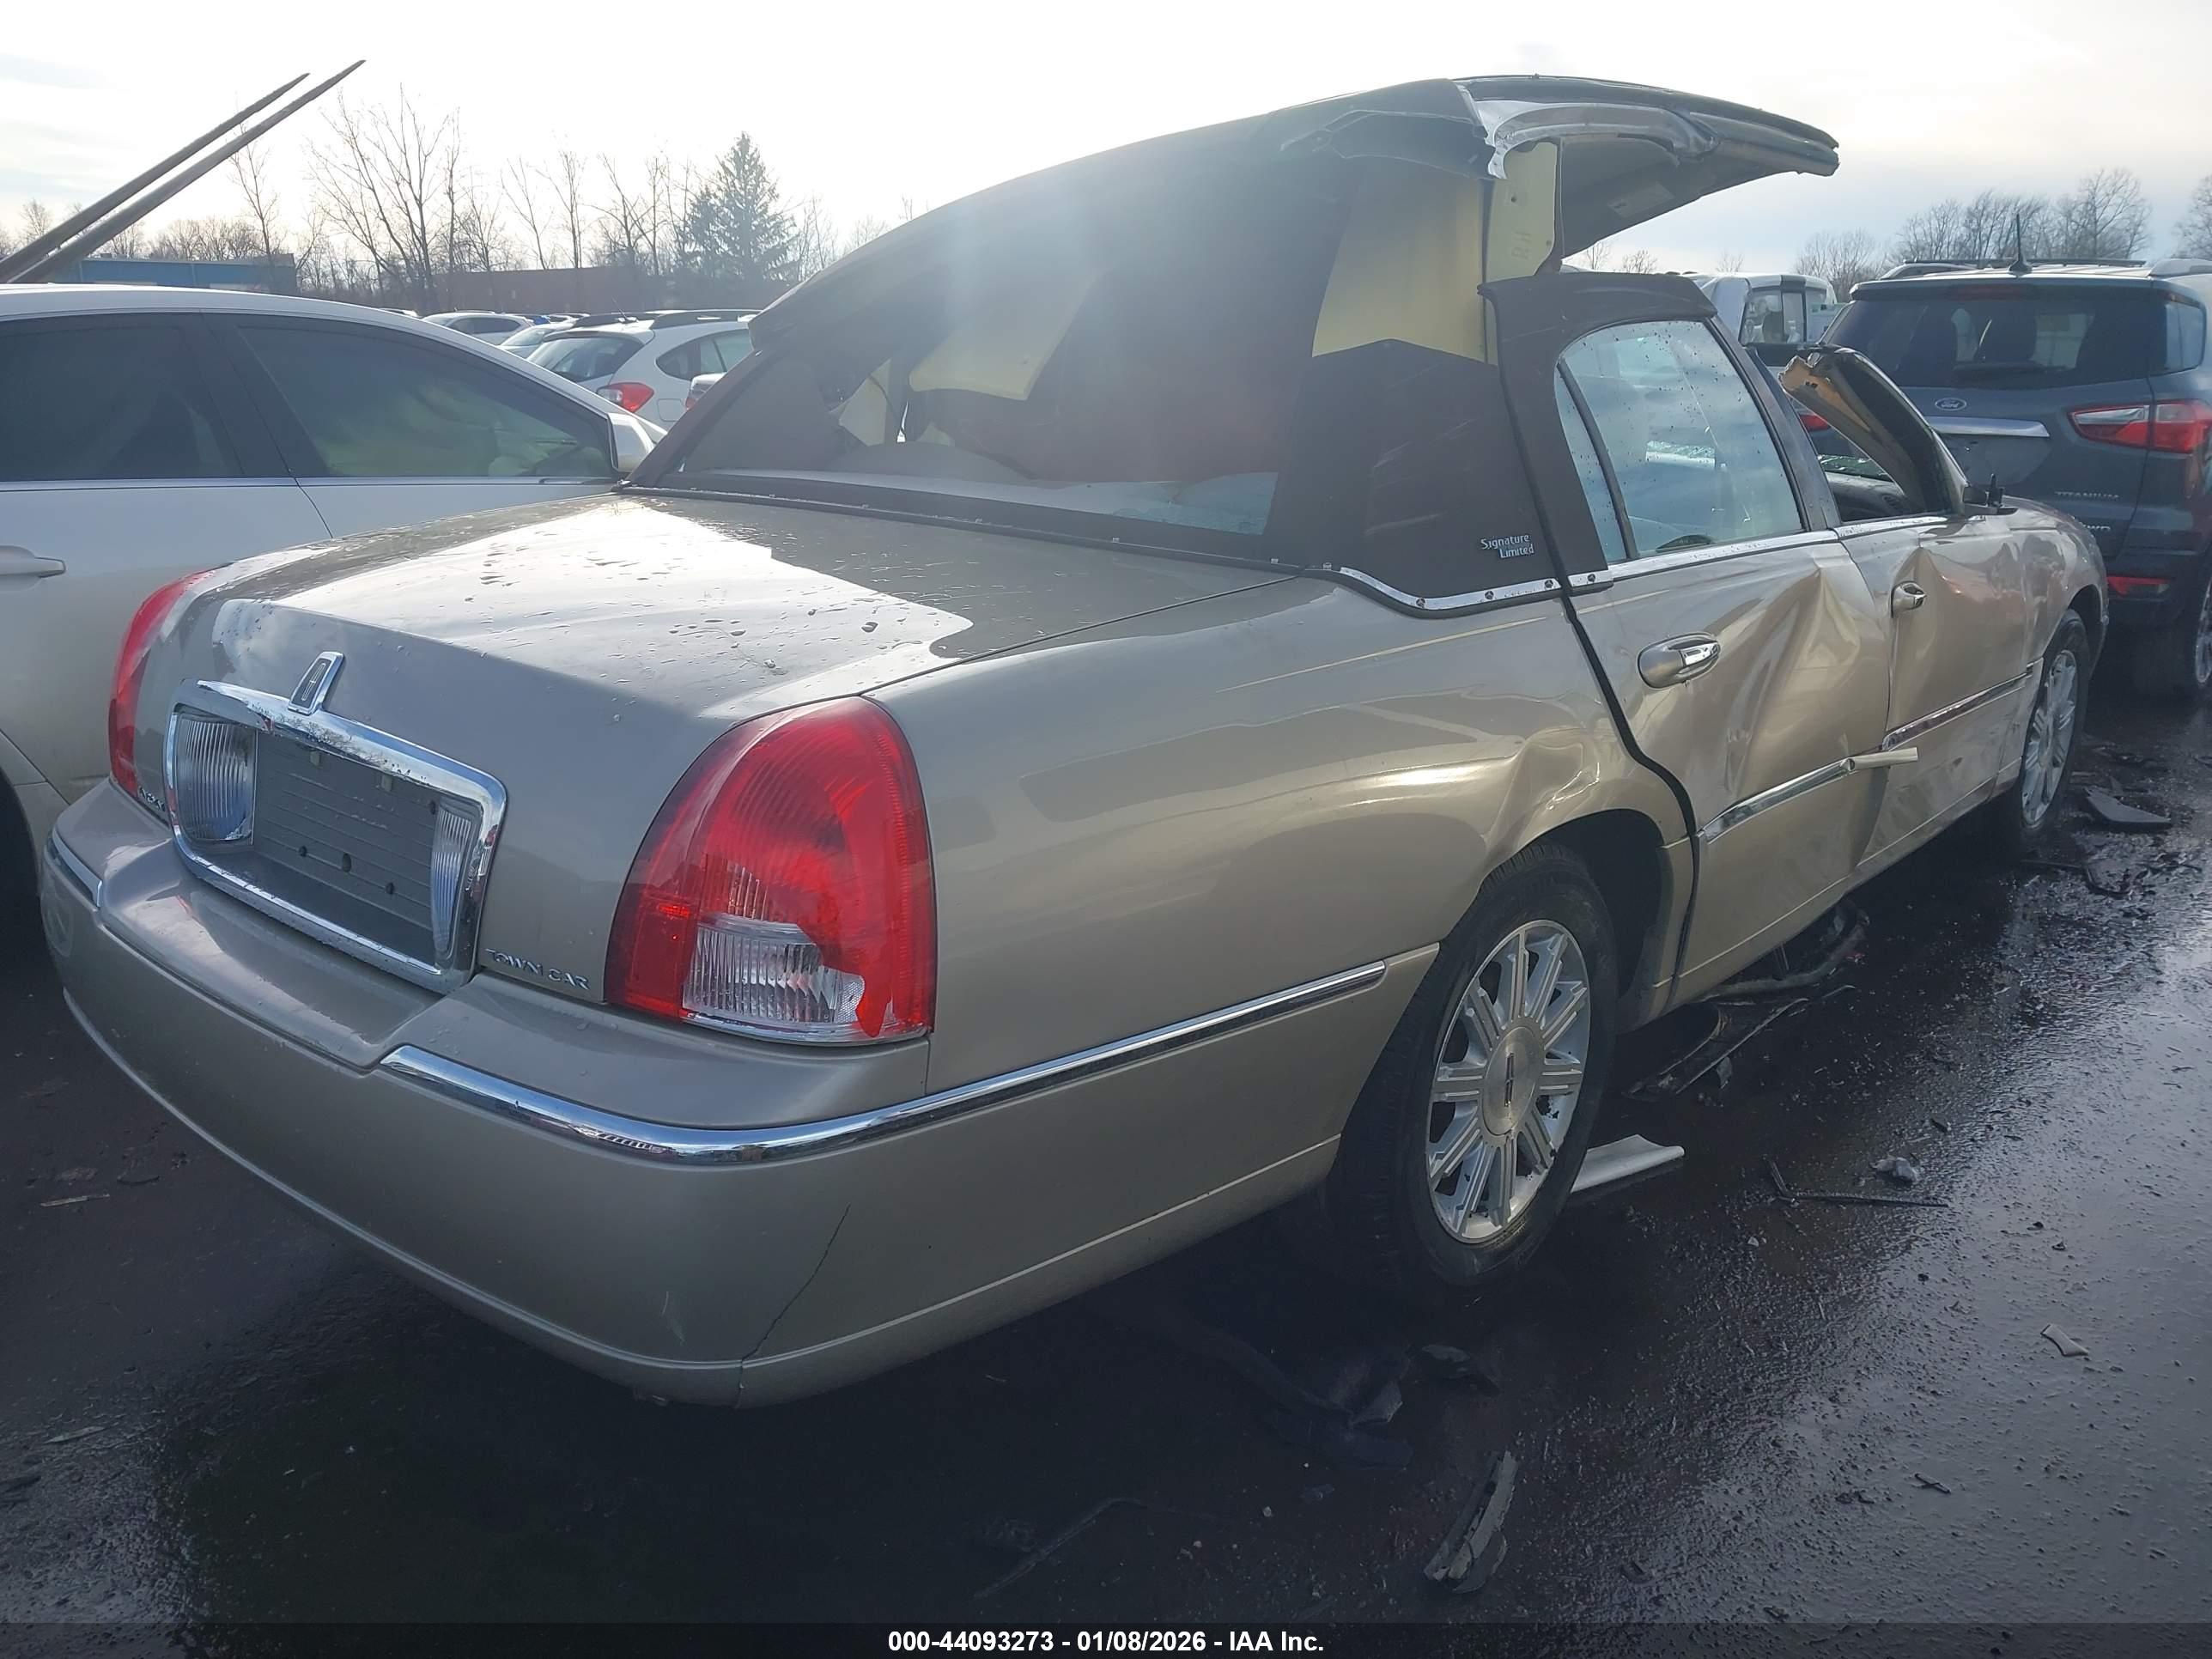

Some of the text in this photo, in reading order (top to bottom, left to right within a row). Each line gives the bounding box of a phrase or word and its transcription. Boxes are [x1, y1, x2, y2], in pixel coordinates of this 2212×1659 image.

[1480, 534, 1529, 550] Signature
[1499, 544, 1534, 558] Limited
[485, 948, 590, 991] TOWN CAR
